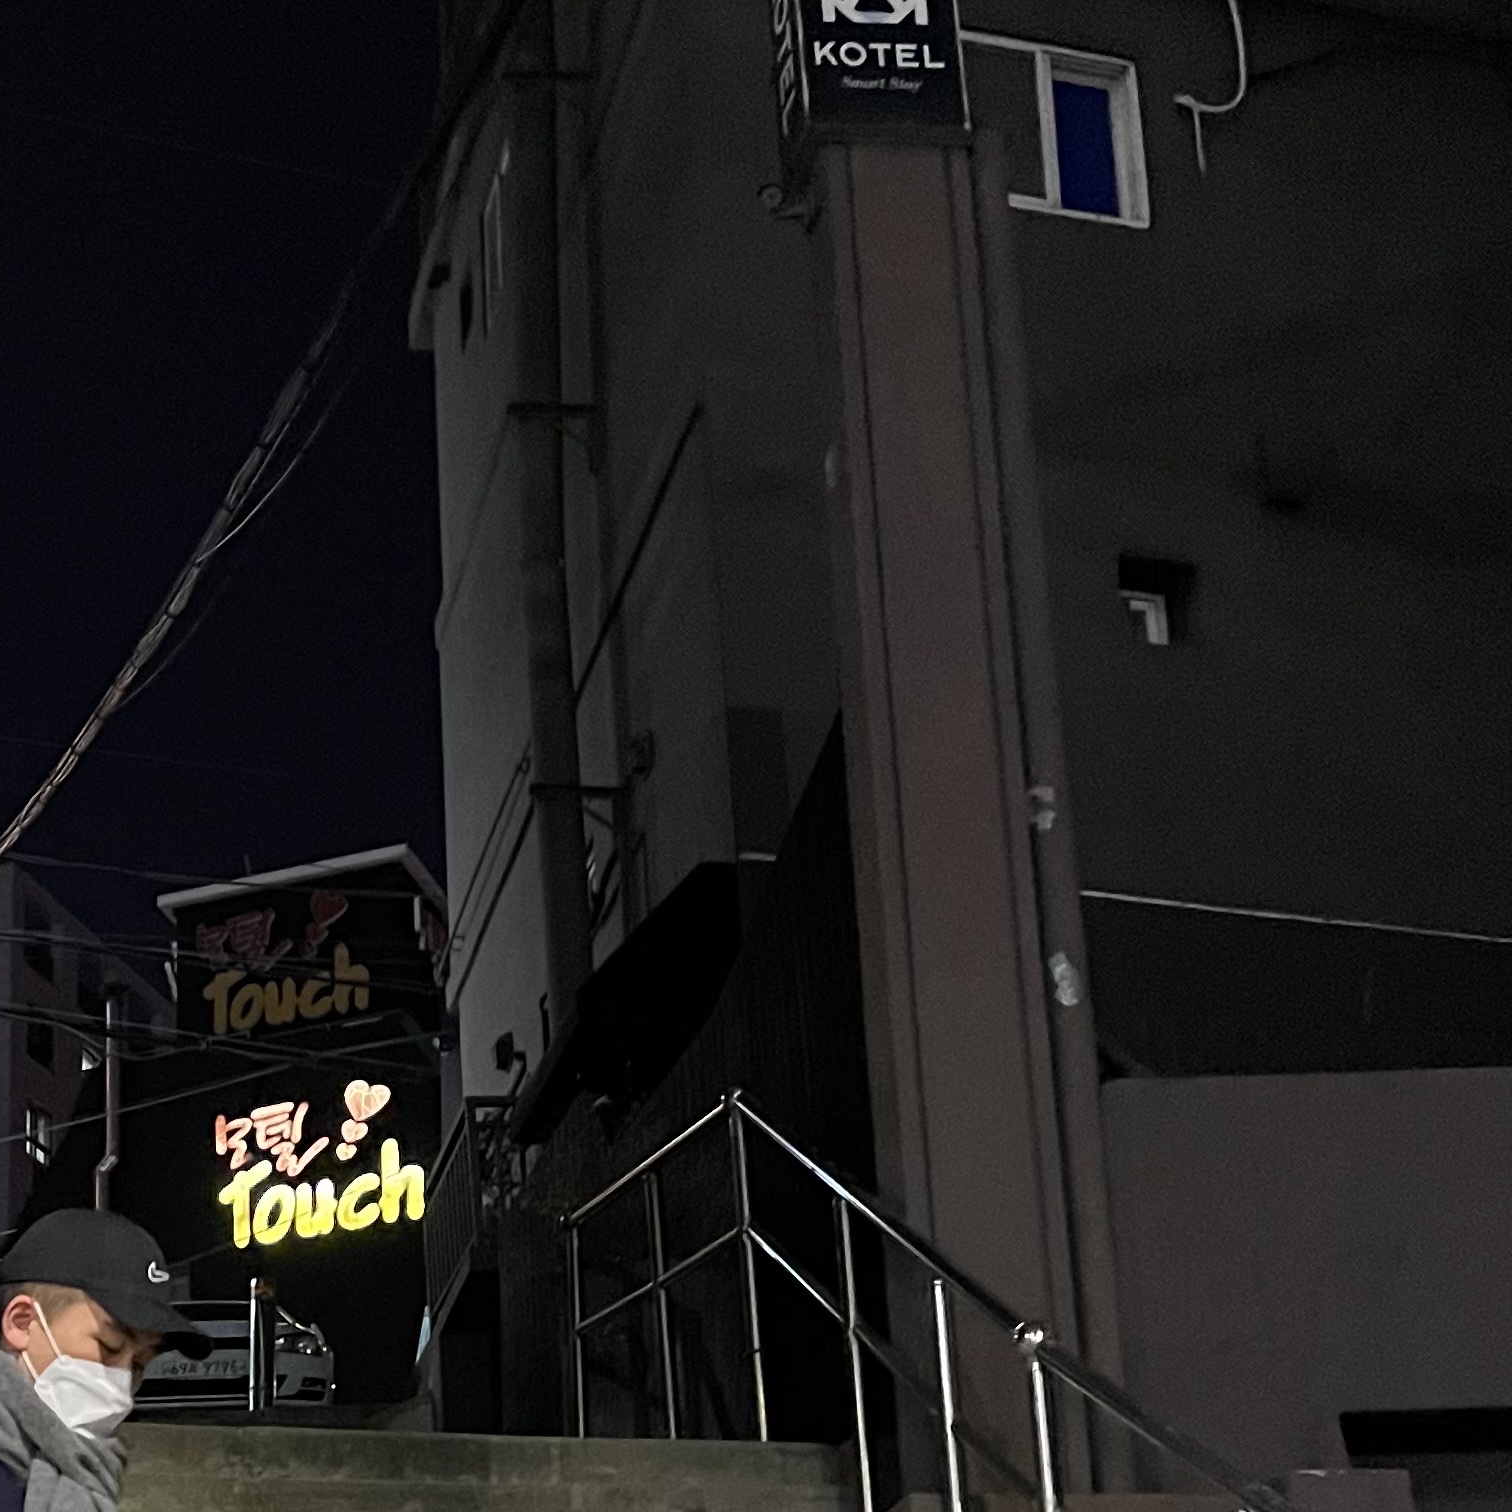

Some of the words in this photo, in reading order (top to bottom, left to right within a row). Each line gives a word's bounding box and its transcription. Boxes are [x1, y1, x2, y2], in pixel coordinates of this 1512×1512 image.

[772, 0, 797, 137] OTEL
[813, 41, 945, 68] KOTEL
[203, 942, 370, 1036] Touch
[218, 1138, 425, 1249] Touch
